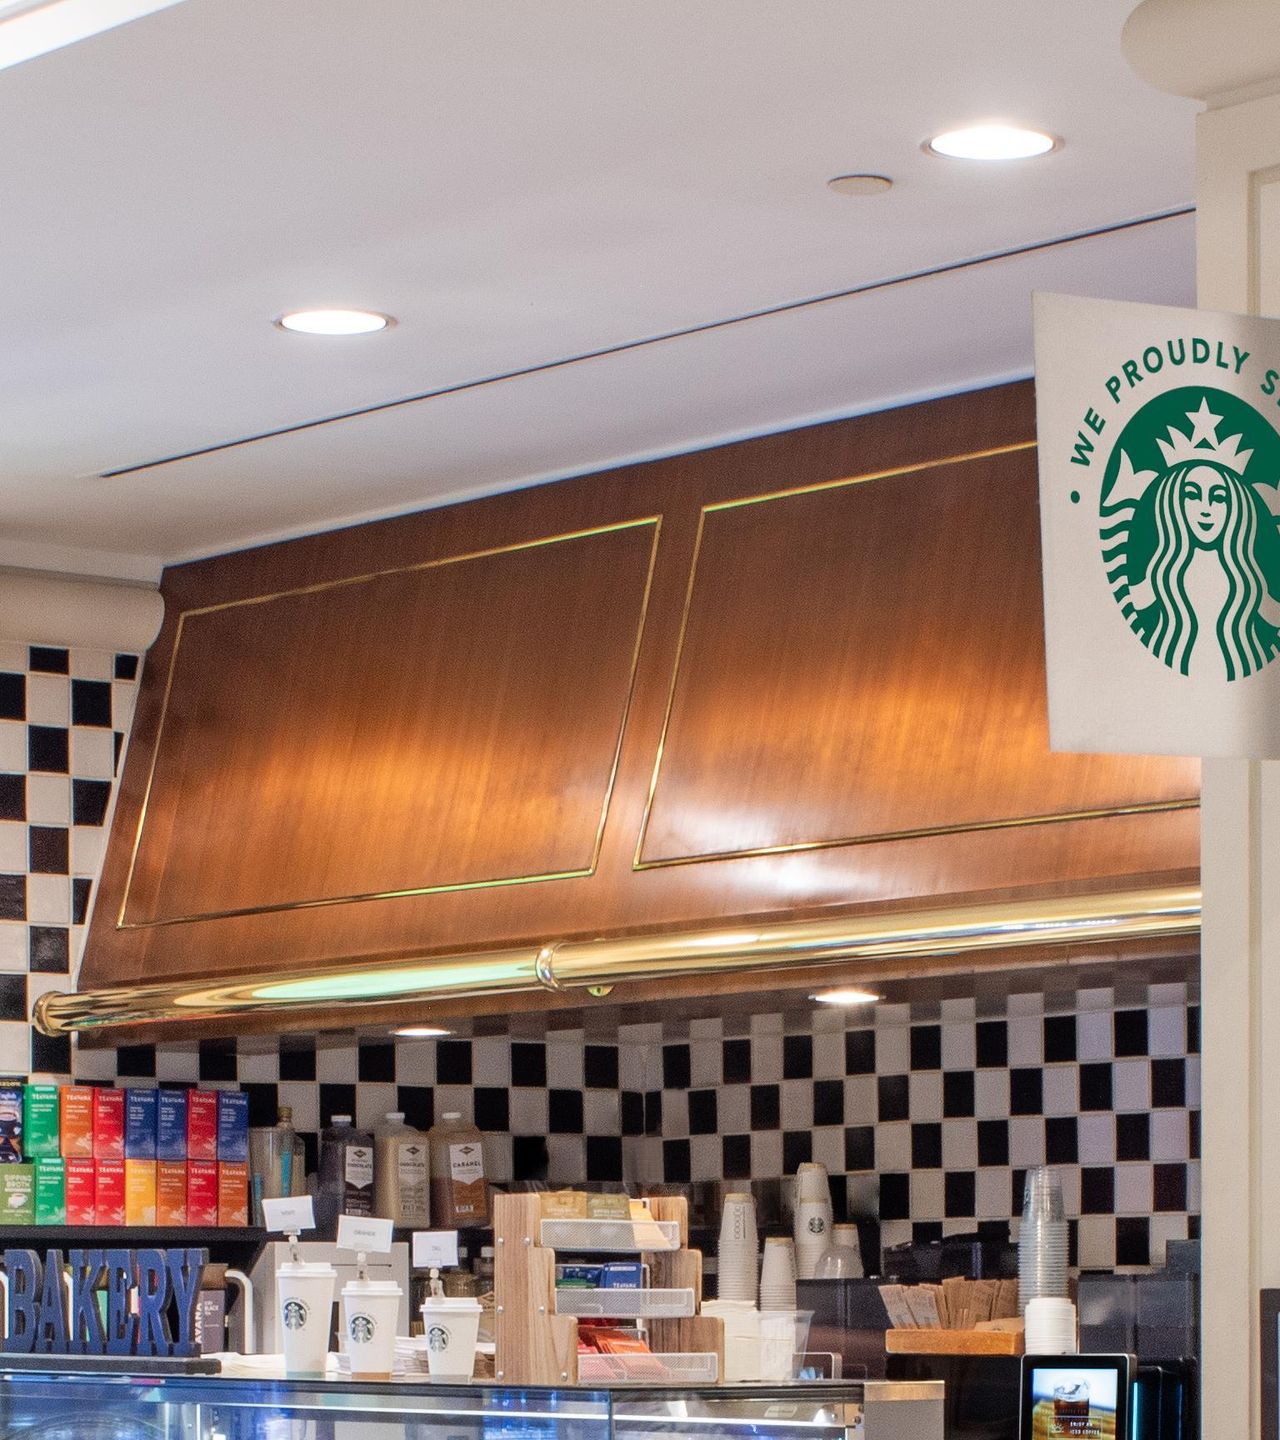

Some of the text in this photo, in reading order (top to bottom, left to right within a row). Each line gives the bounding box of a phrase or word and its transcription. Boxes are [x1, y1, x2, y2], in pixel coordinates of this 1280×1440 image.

[1070, 407, 1106, 468] WE
[1104, 337, 1250, 404] PROUDLY
[4, 1248, 205, 1356] BAKERY
